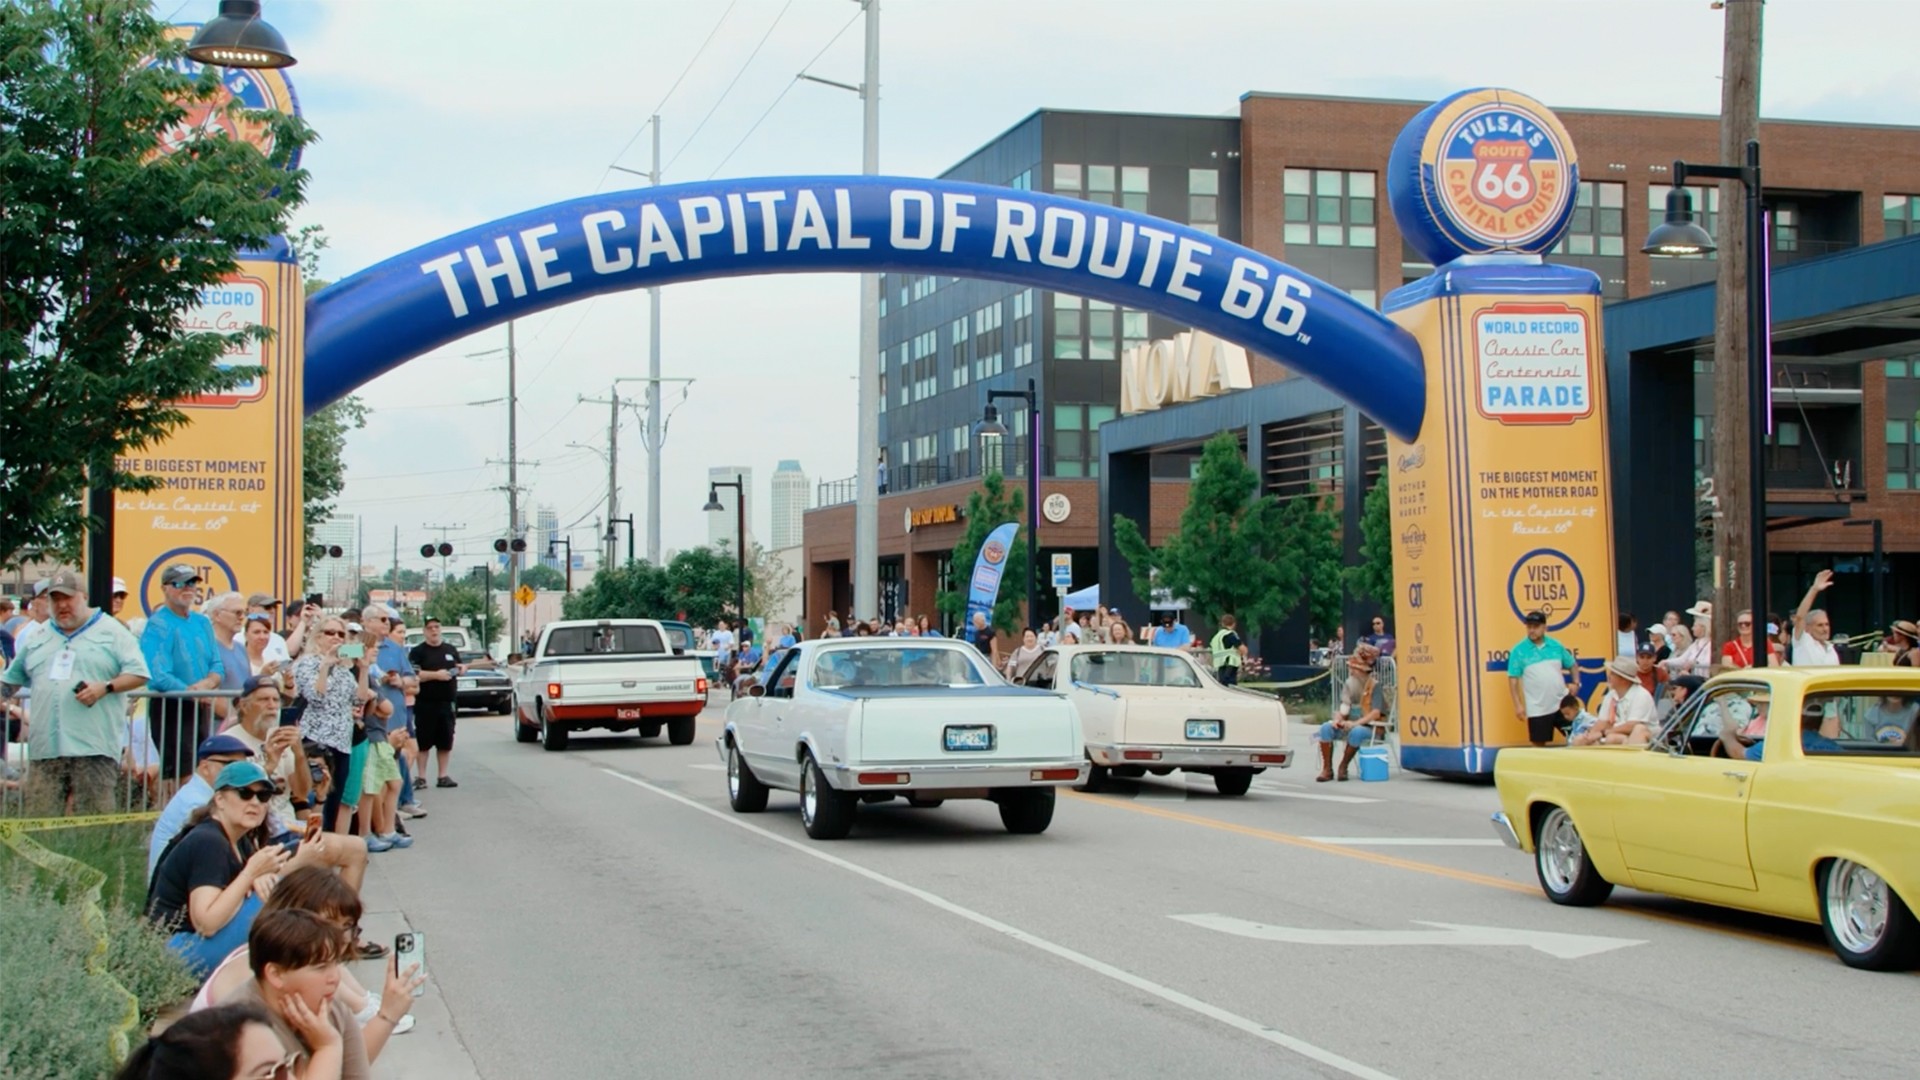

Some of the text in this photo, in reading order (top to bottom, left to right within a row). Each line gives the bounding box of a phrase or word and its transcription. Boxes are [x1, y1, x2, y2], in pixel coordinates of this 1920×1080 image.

[1459, 116, 1544, 147] TULSA'S
[1479, 145, 1527, 157] ROUTE
[1478, 163, 1530, 199] 66
[1450, 169, 1556, 233] CAPITAL CRUISE
[420, 223, 572, 318] THE
[582, 188, 871, 275] CAPITAL
[890, 189, 976, 253] OF
[992, 198, 1212, 302] ROUTE
[1220, 256, 1312, 337] 66
[203, 291, 254, 306] ECORD
[1484, 321, 1579, 334] WORLD RECORD
[1484, 339, 1584, 356] Classic Car
[1121, 328, 1253, 414] NOMA
[1486, 361, 1582, 378] Centennial
[1488, 386, 1584, 406] PARADE
[115, 459, 266, 473] THE BIGGEST MOMENT
[167, 477, 225, 490] MOTHER
[228, 479, 265, 490] ROAD
[1479, 470, 1598, 483] THE BIGGEST MOMENT
[1398, 480, 1426, 492] MOTHER
[1480, 486, 1598, 499] ON THE MOTHER ROAD
[139, 500, 168, 511] the
[172, 497, 237, 514] Capital
[240, 502, 262, 514] of
[1400, 506, 1427, 517] MARKET
[1482, 504, 1597, 519] in the Capital of
[151, 516, 201, 531] Route
[1512, 520, 1553, 535] Route
[1527, 565, 1563, 581] VISIT
[1523, 584, 1569, 600] TULSA
[1409, 715, 1439, 738] COX
